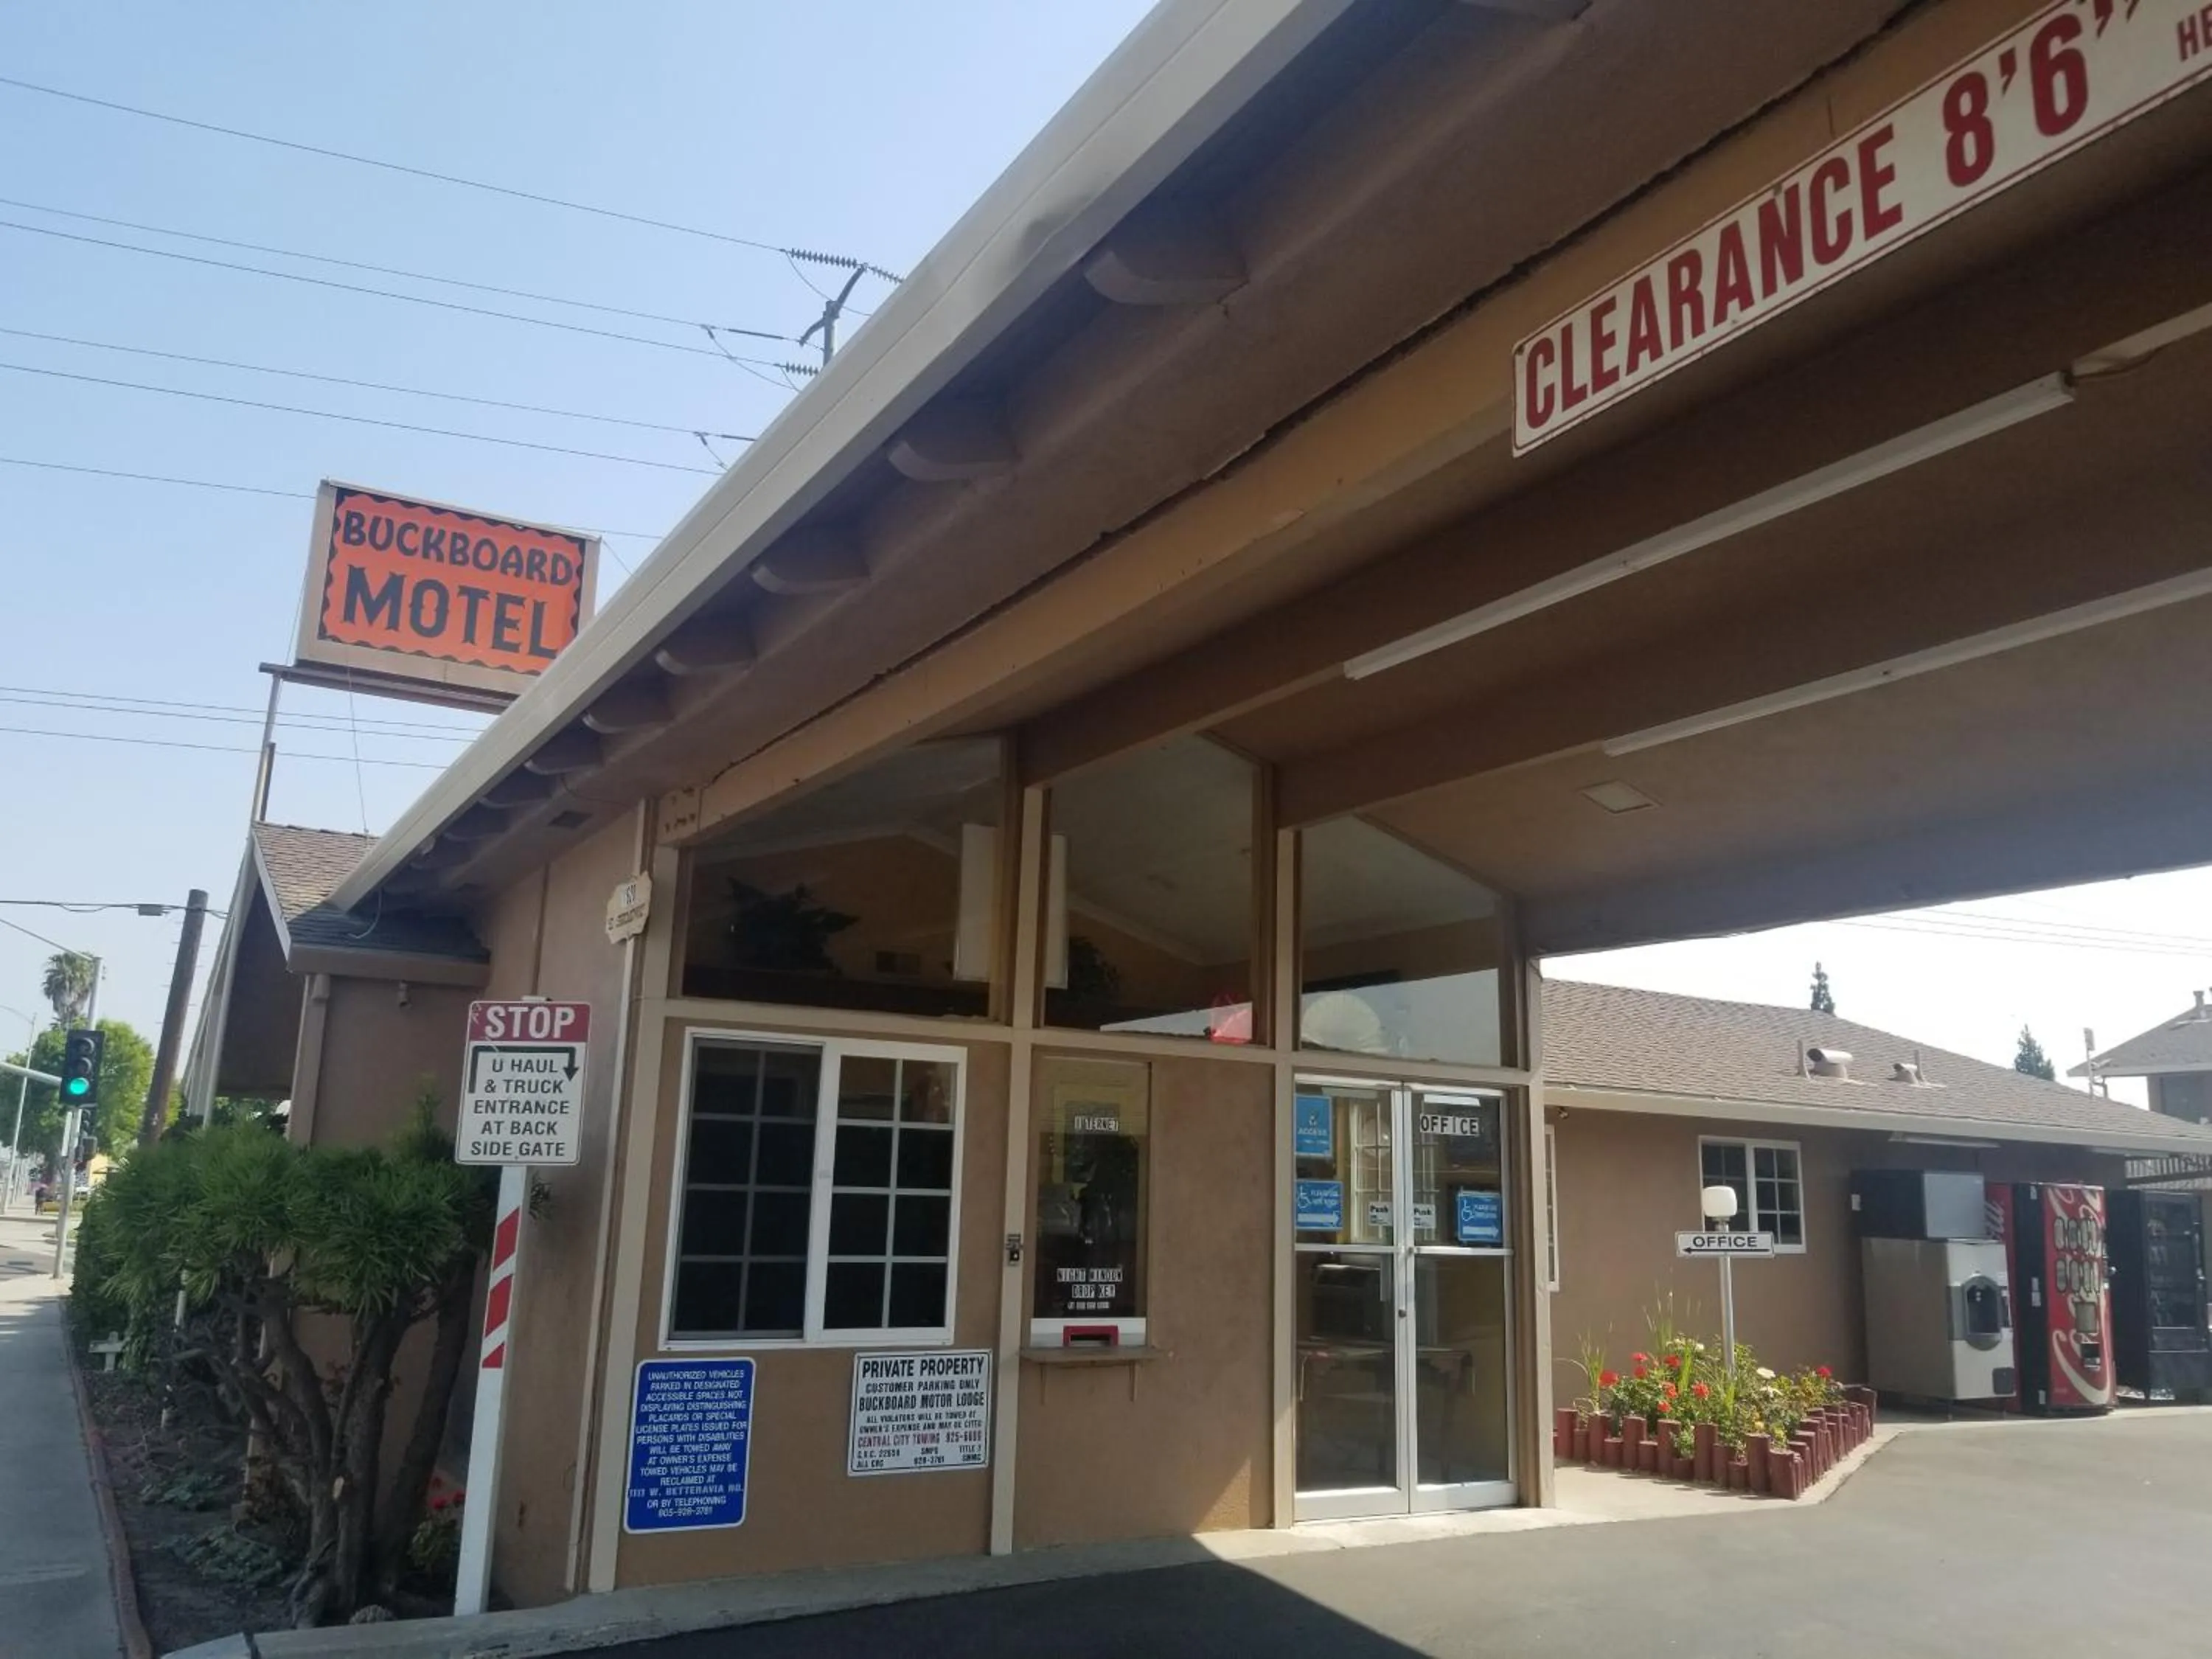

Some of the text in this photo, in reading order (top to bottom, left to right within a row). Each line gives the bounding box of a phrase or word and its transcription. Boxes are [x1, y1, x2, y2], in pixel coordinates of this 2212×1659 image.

[1526, 122, 1903, 429] CLEARANCE
[342, 510, 573, 585] BUCKBOARD
[341, 564, 560, 659] MOTEL
[484, 1005, 575, 1039] STOP
[492, 1059, 558, 1073] U HAUL
[484, 1079, 563, 1093] & TRUCK
[473, 1099, 570, 1114] ENTRANCE
[481, 1121, 557, 1135] AT BACK
[1420, 1115, 1479, 1135] OFFICE
[471, 1141, 565, 1157] SIDE GATE
[1693, 1236, 1758, 1248] OFFICE
[862, 1357, 984, 1378] PRIVATE PROPERTY
[648, 1370, 744, 1380] UNAUTHORIZED VEHICLES
[650, 1380, 740, 1391] PARKED IN DESIGNATED
[866, 1379, 980, 1394] CUSTOMER PARKING ONLY
[646, 1391, 744, 1402] ACCESSIBLE SPACES NOT
[859, 1392, 984, 1411] BUCKBOARD MOTOR LODGE
[640, 1401, 747, 1412] DISPLAYING DISTINGUISHING
[649, 1411, 737, 1422] PLACARDS OR SPECIAL
[866, 1410, 977, 1424] ALL VIOLATORS WILL BE TOWED AT
[636, 1422, 747, 1434] LICENSE PLATES ISSUED FOR
[891, 1423, 921, 1433] EXPENSE
[923, 1422, 936, 1430] AND
[939, 1422, 951, 1430] MAY
[954, 1420, 962, 1428] BE
[637, 1432, 745, 1444] PERSONS WITH DISABILITIES
[858, 1434, 891, 1448] CENTRAL
[893, 1433, 911, 1446] CITY
[913, 1433, 940, 1444] TOWING
[649, 1443, 732, 1455] WILL BE TOWED AWAY
[647, 1453, 731, 1465] AT OWNER'S EXPENSE
[640, 1463, 738, 1477] TOWED VEHICLES MAY BE
[660, 1475, 716, 1486] RECLAIMED AT
[647, 1496, 726, 1509] OR BY TELEPHONING
